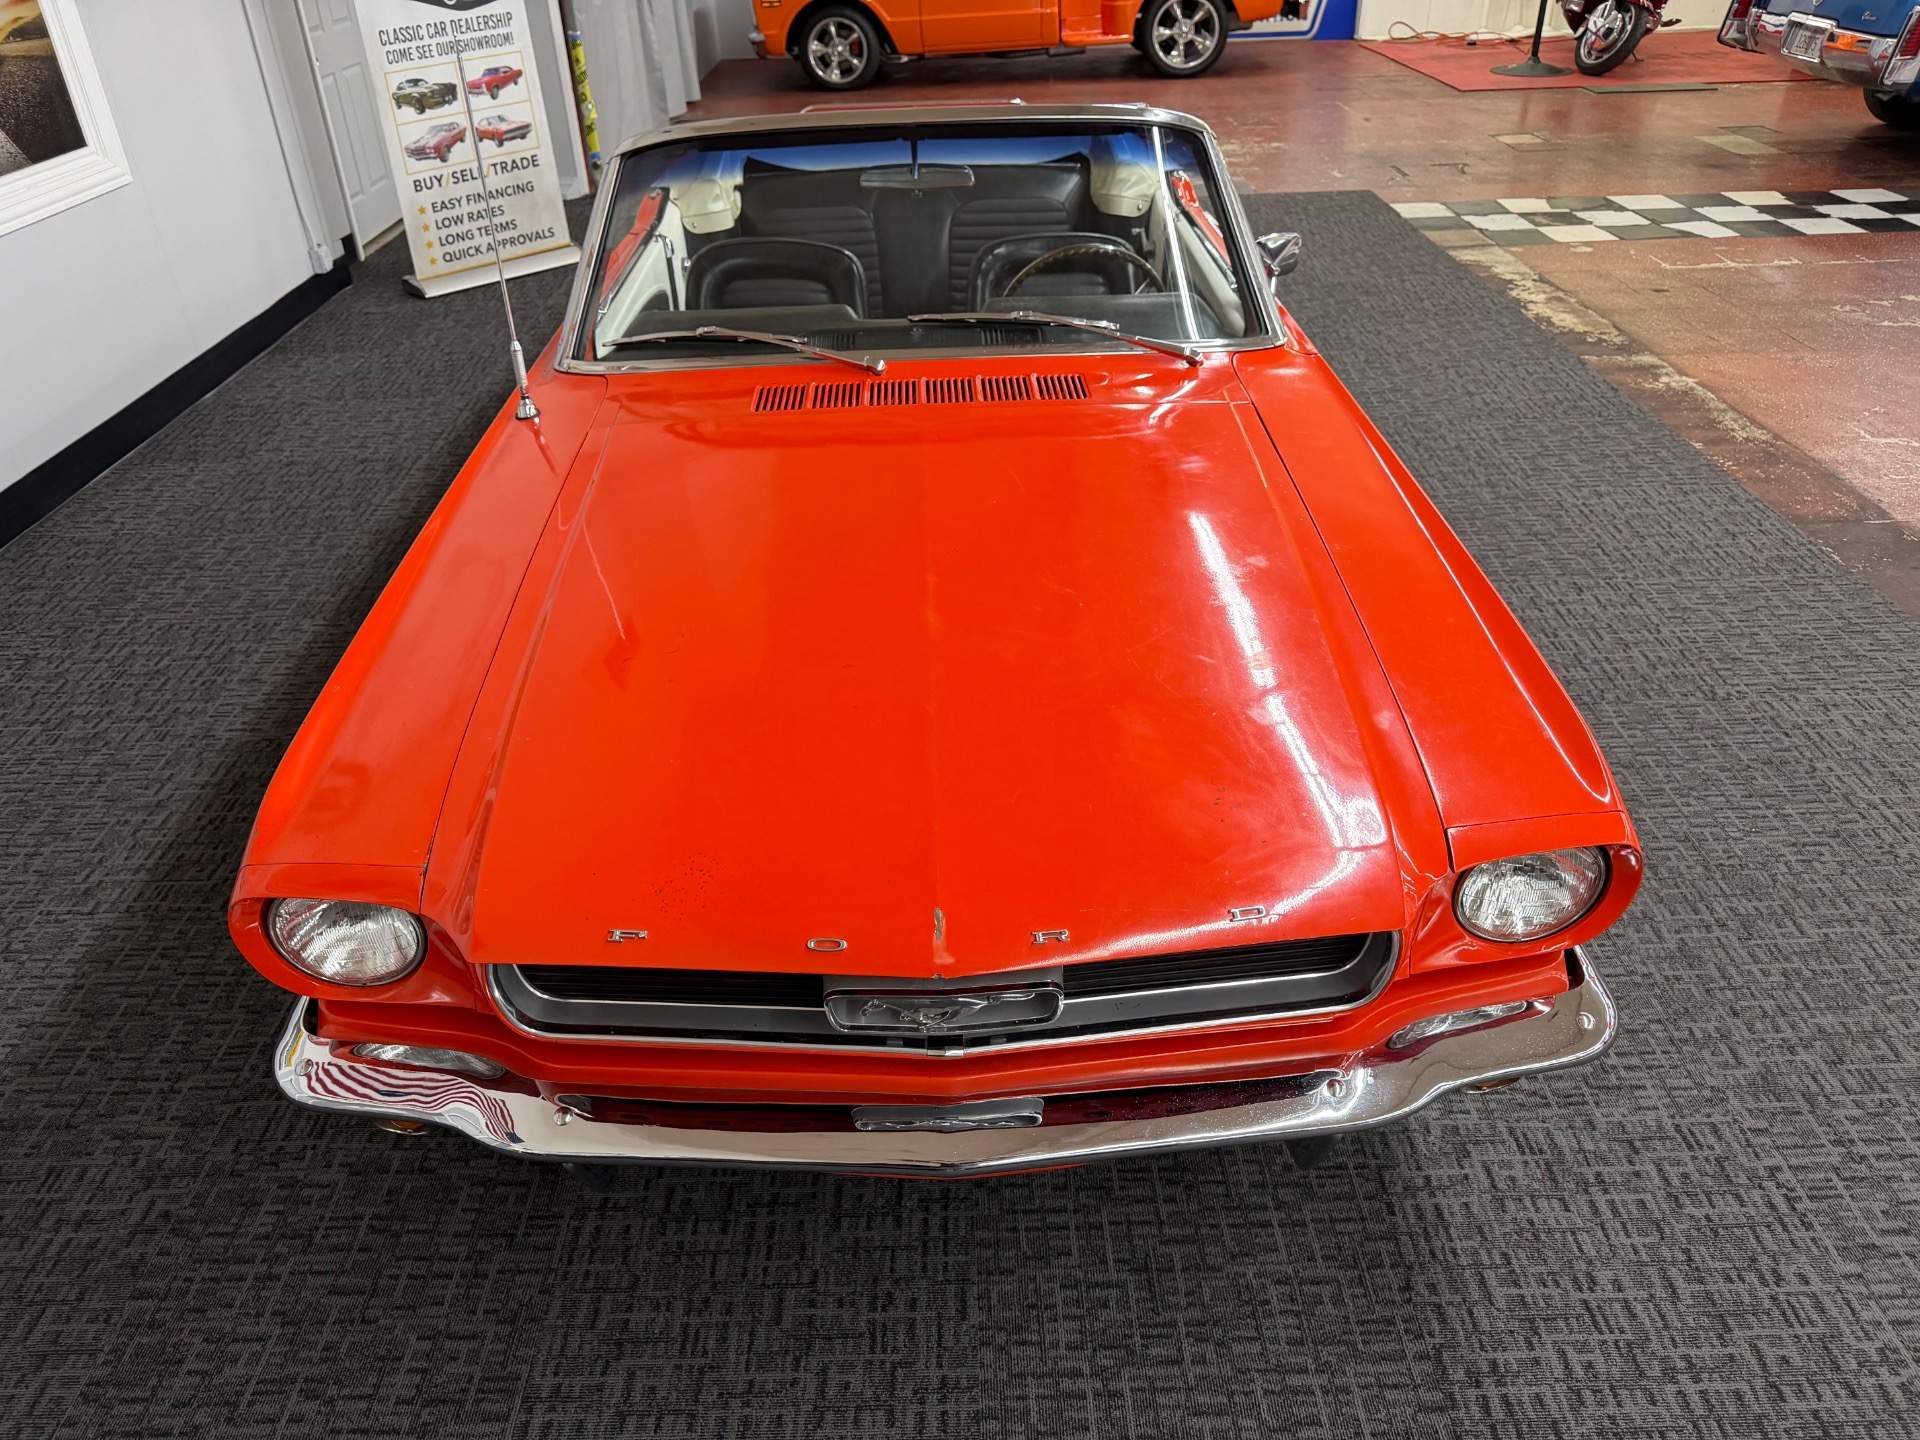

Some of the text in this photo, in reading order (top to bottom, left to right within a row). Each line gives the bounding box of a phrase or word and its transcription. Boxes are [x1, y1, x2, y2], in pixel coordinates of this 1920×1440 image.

[378, 11, 514, 46] CLASSIC CAR DEALERSHIP
[385, 31, 515, 65] COME SEE OUR SHOWROOM!
[431, 180, 535, 214] EASY FINANCING
[434, 204, 506, 231] LOW RATES
[438, 219, 518, 247] LONG TERMS
[442, 245, 484, 263] QUICK
[607, 904, 1267, 953] FORD
